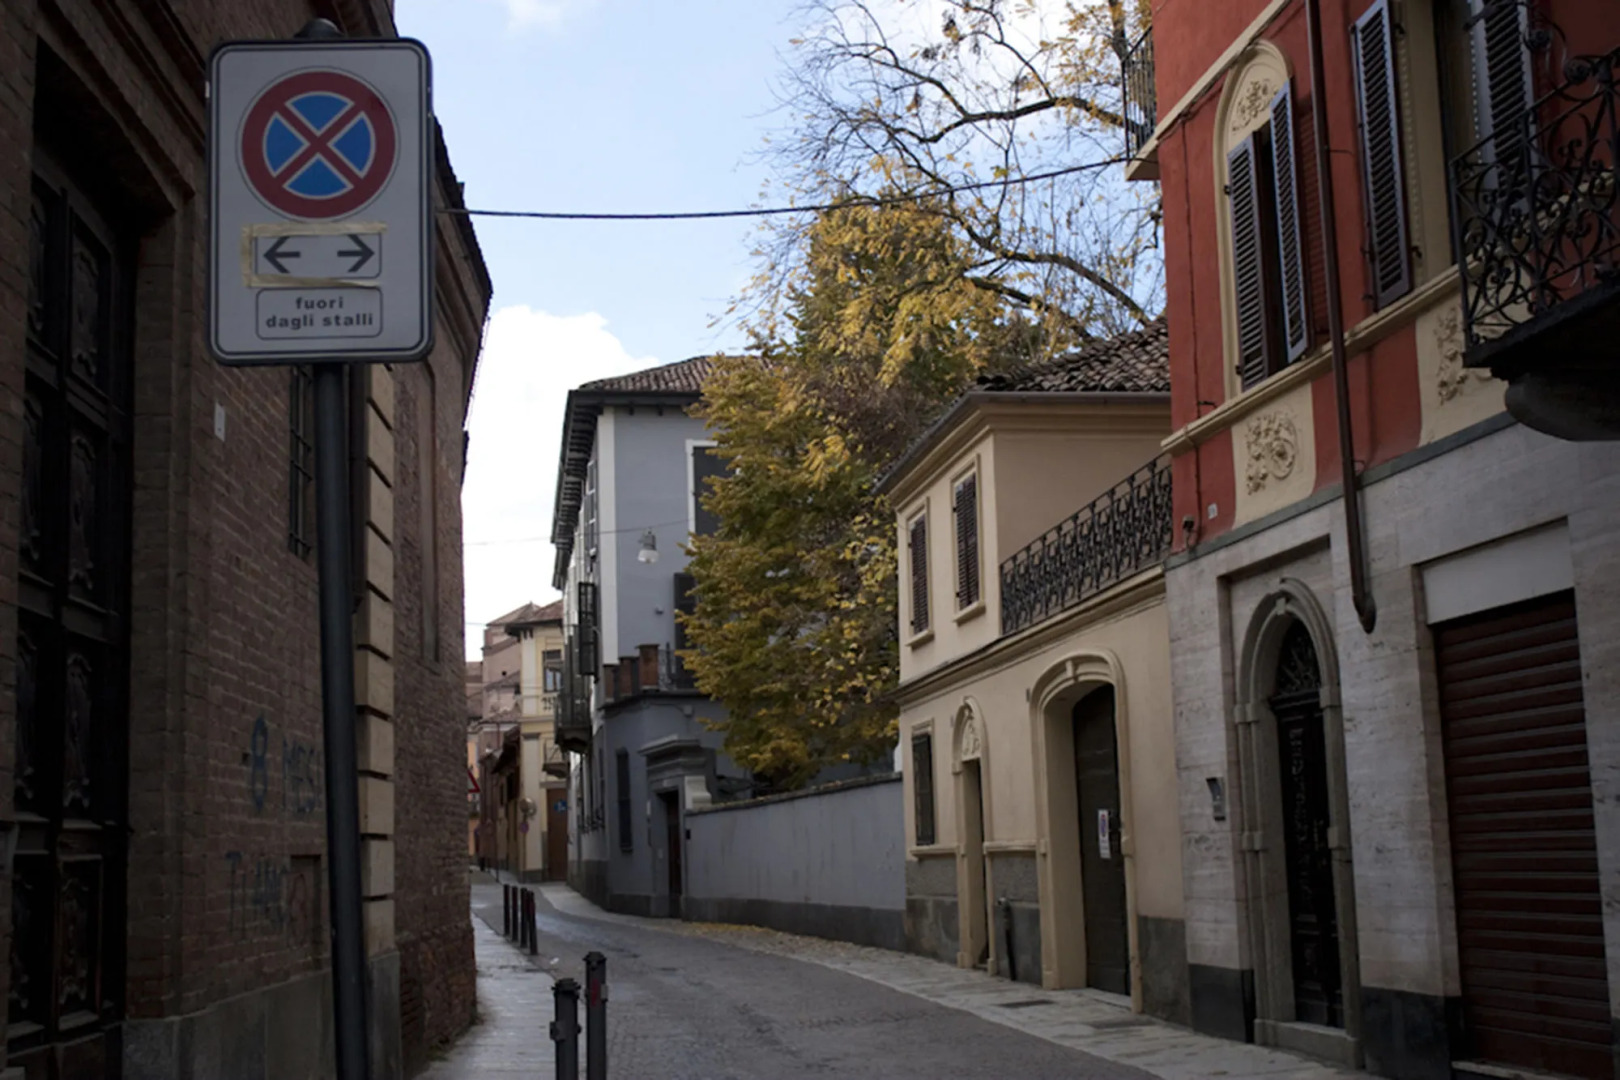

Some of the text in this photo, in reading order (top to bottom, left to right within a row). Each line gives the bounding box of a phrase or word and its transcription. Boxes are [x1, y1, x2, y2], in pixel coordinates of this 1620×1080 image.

[296, 296, 344, 310] fuori
[266, 313, 373, 330] dagli stalli
